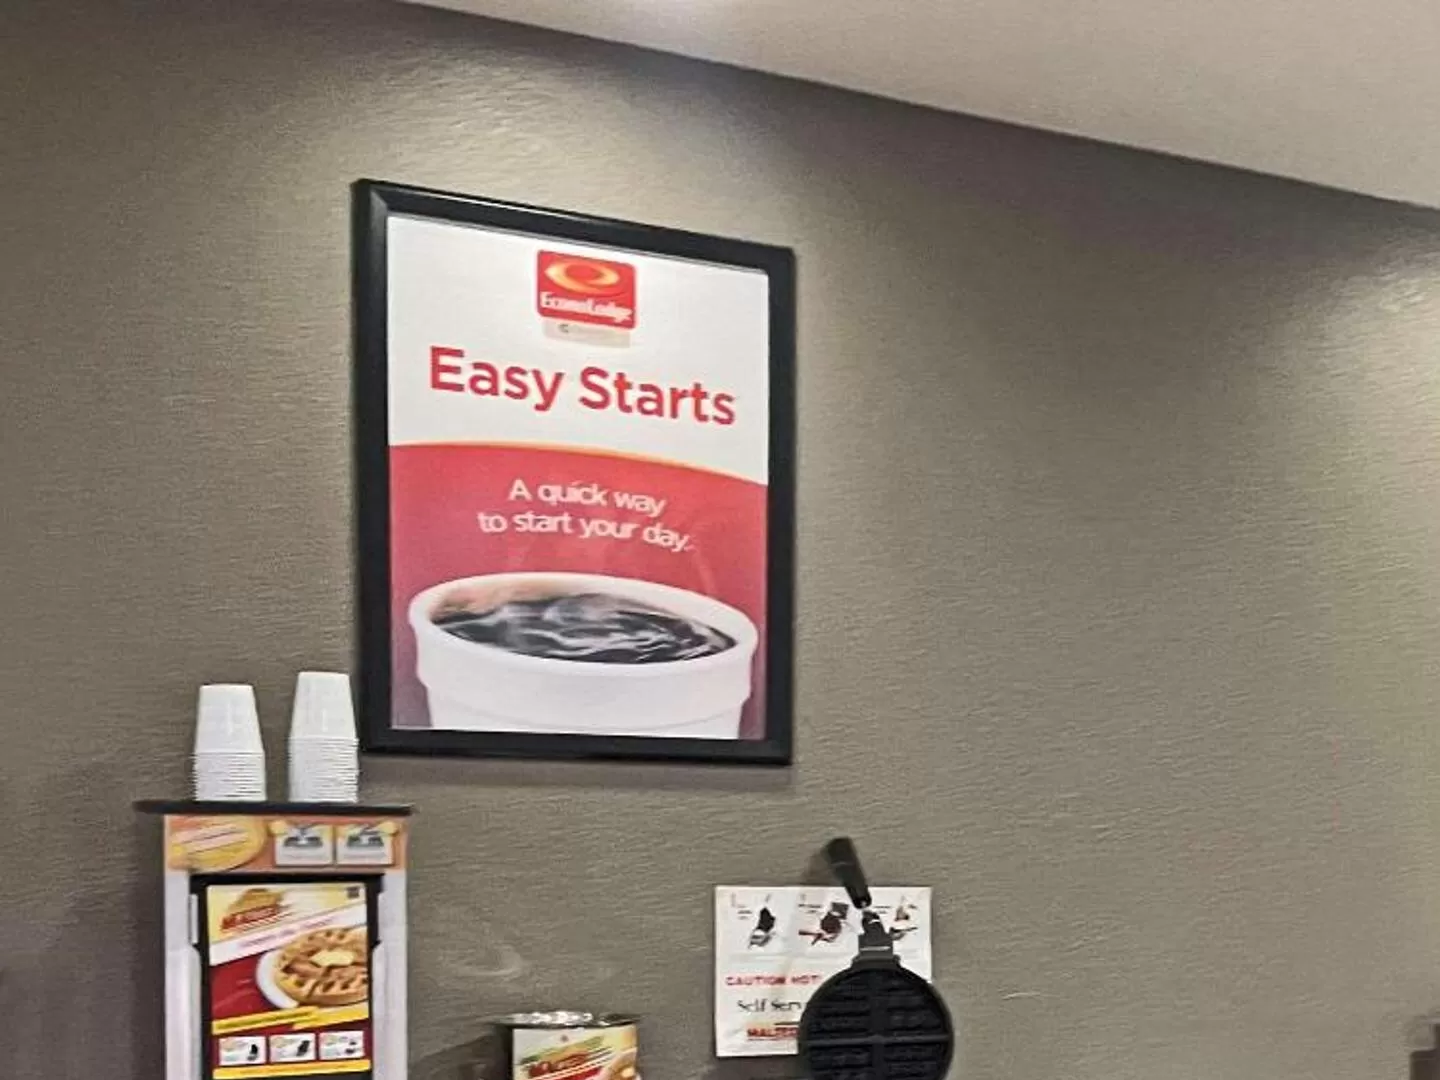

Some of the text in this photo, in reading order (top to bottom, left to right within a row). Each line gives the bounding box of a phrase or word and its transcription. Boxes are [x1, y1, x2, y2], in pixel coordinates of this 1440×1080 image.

[430, 345, 737, 426] Easy Starts
[508, 478, 667, 518] A quick way
[477, 511, 508, 533] to
[513, 510, 574, 535] start
[578, 517, 640, 540] your
[725, 973, 786, 987] CAUTION
[736, 998, 767, 1012] Self
